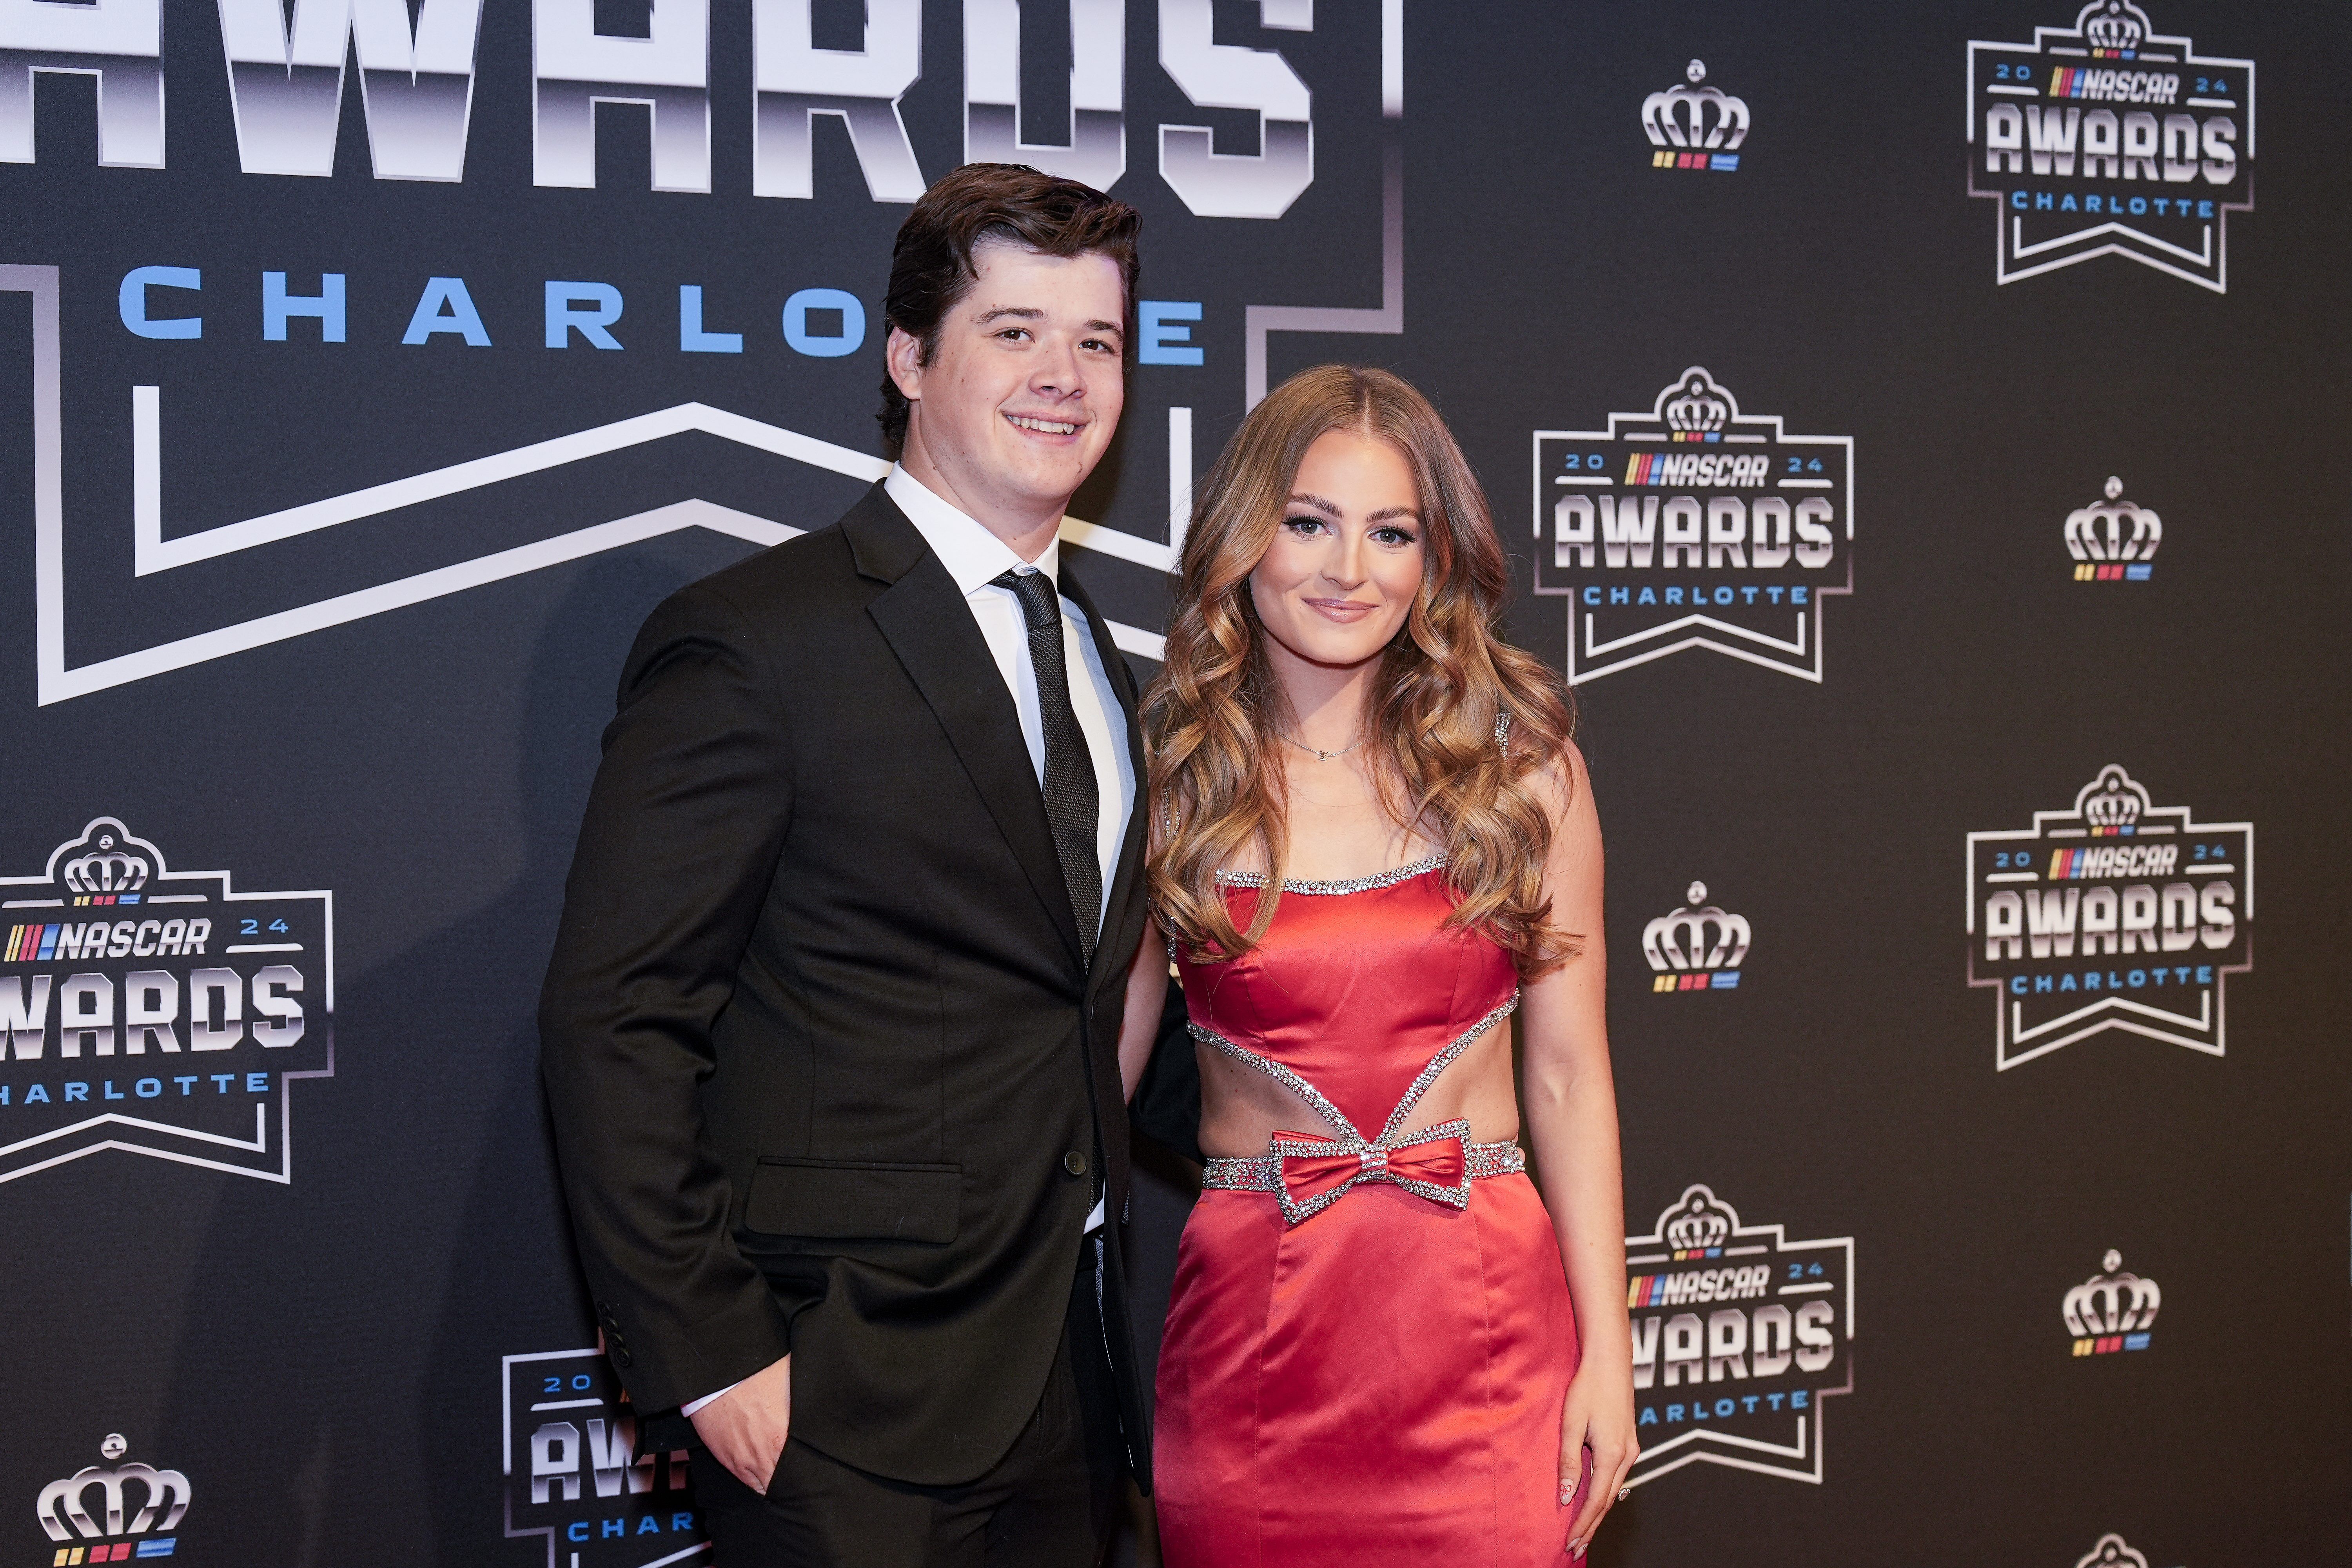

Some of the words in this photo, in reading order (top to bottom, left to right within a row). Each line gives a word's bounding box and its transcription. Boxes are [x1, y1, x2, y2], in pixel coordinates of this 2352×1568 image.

[1996, 63, 2031, 81] 20
[2080, 69, 2180, 105] NASCAR
[2196, 77, 2228, 93] 24
[1986, 102, 2236, 185] AWARDS
[2011, 190, 2214, 219] CHARLOTTE
[118, 265, 1205, 366] CHARLOE
[1565, 453, 1604, 470] 20
[1659, 454, 1770, 487] NASCAR
[1788, 457, 1823, 473] 24
[1554, 494, 1834, 568] AWARDS
[1583, 585, 1808, 606] CHARLOTTE
[1996, 852, 2031, 867] 20
[2079, 844, 2178, 879] NASCAR
[2195, 844, 2225, 859] 24
[54, 918, 212, 960] NASCAR
[240, 918, 289, 935] 24
[1986, 880, 2235, 961] AWARDS
[2011, 965, 2212, 995] CHARLOTTE
[1661, 1264, 1771, 1307] NASCAR
[1788, 1263, 1823, 1279] 24
[543, 1374, 592, 1393] 20
